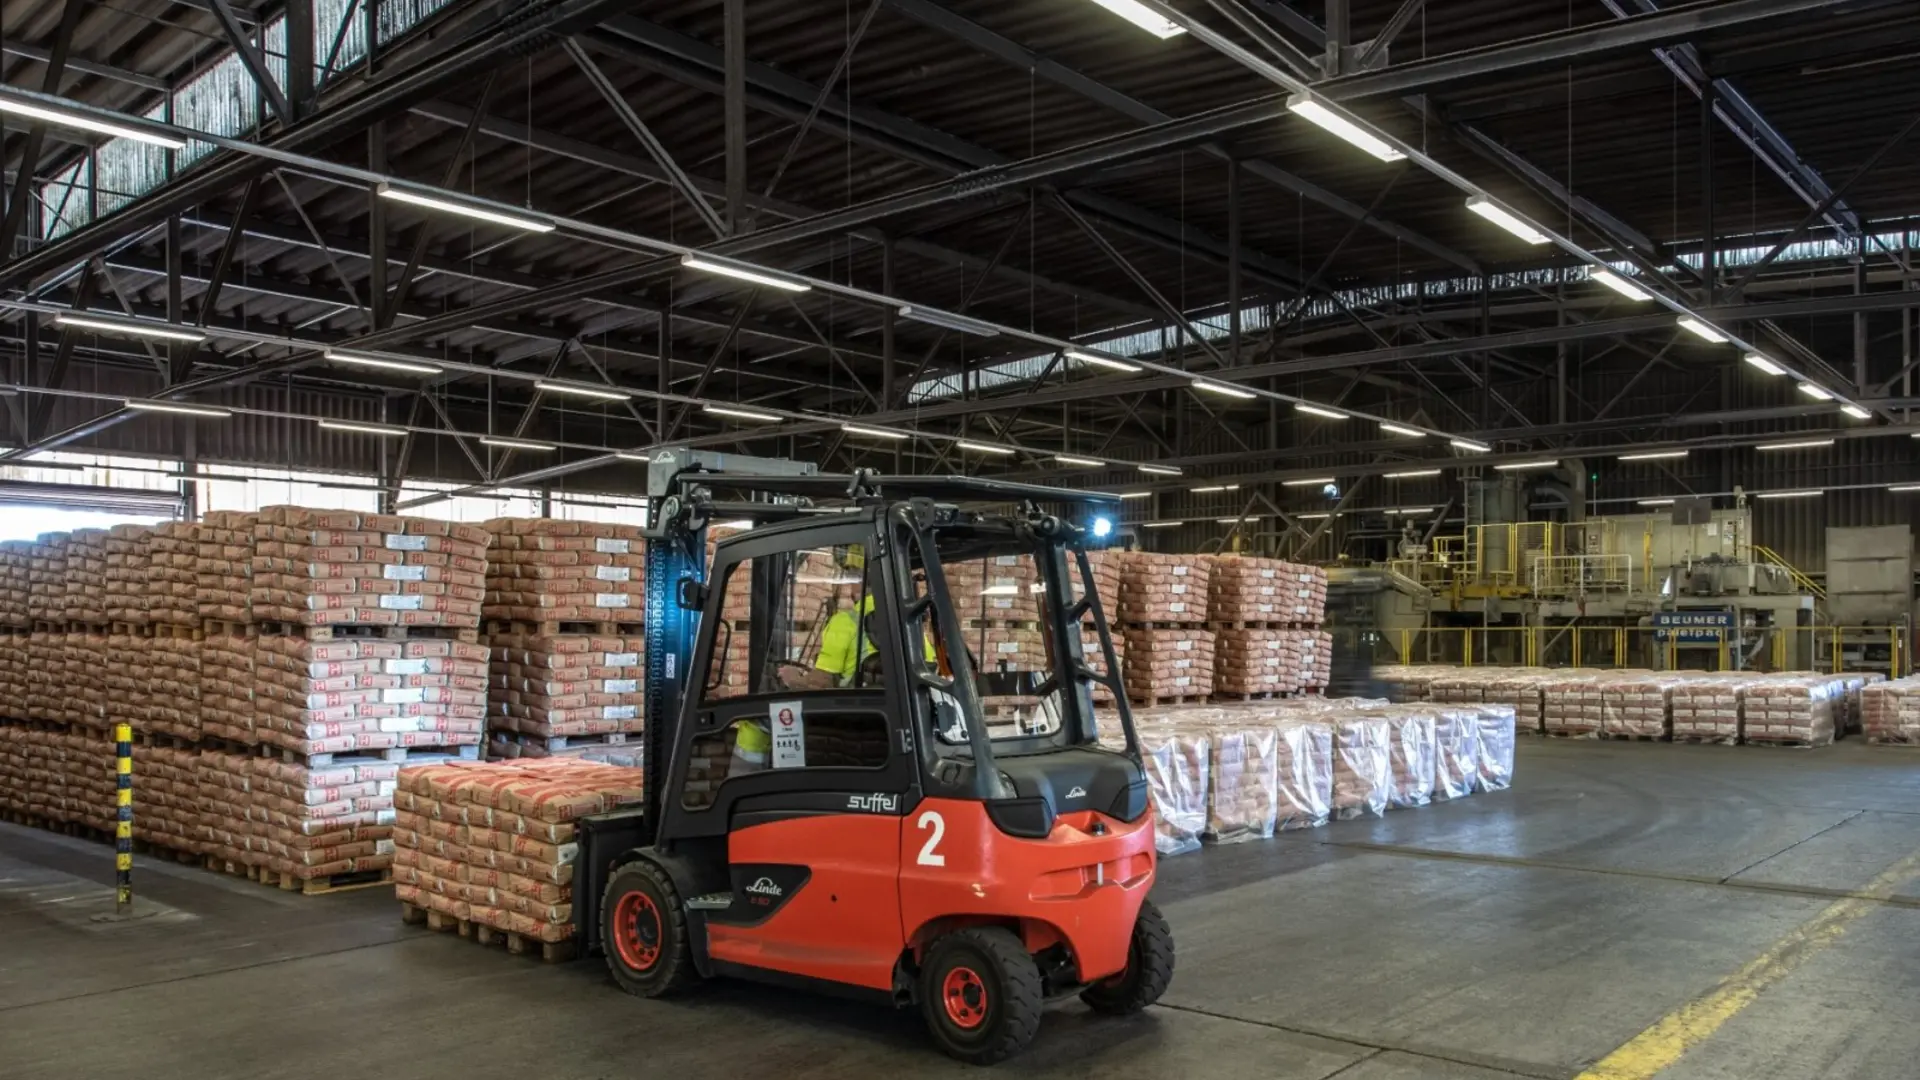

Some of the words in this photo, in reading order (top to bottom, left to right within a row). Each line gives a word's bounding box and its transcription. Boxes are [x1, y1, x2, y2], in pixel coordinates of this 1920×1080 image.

[1660, 615, 1727, 624] BEUMER
[847, 793, 897, 812] suffel
[917, 811, 945, 866] 2
[746, 877, 782, 896] Linde
